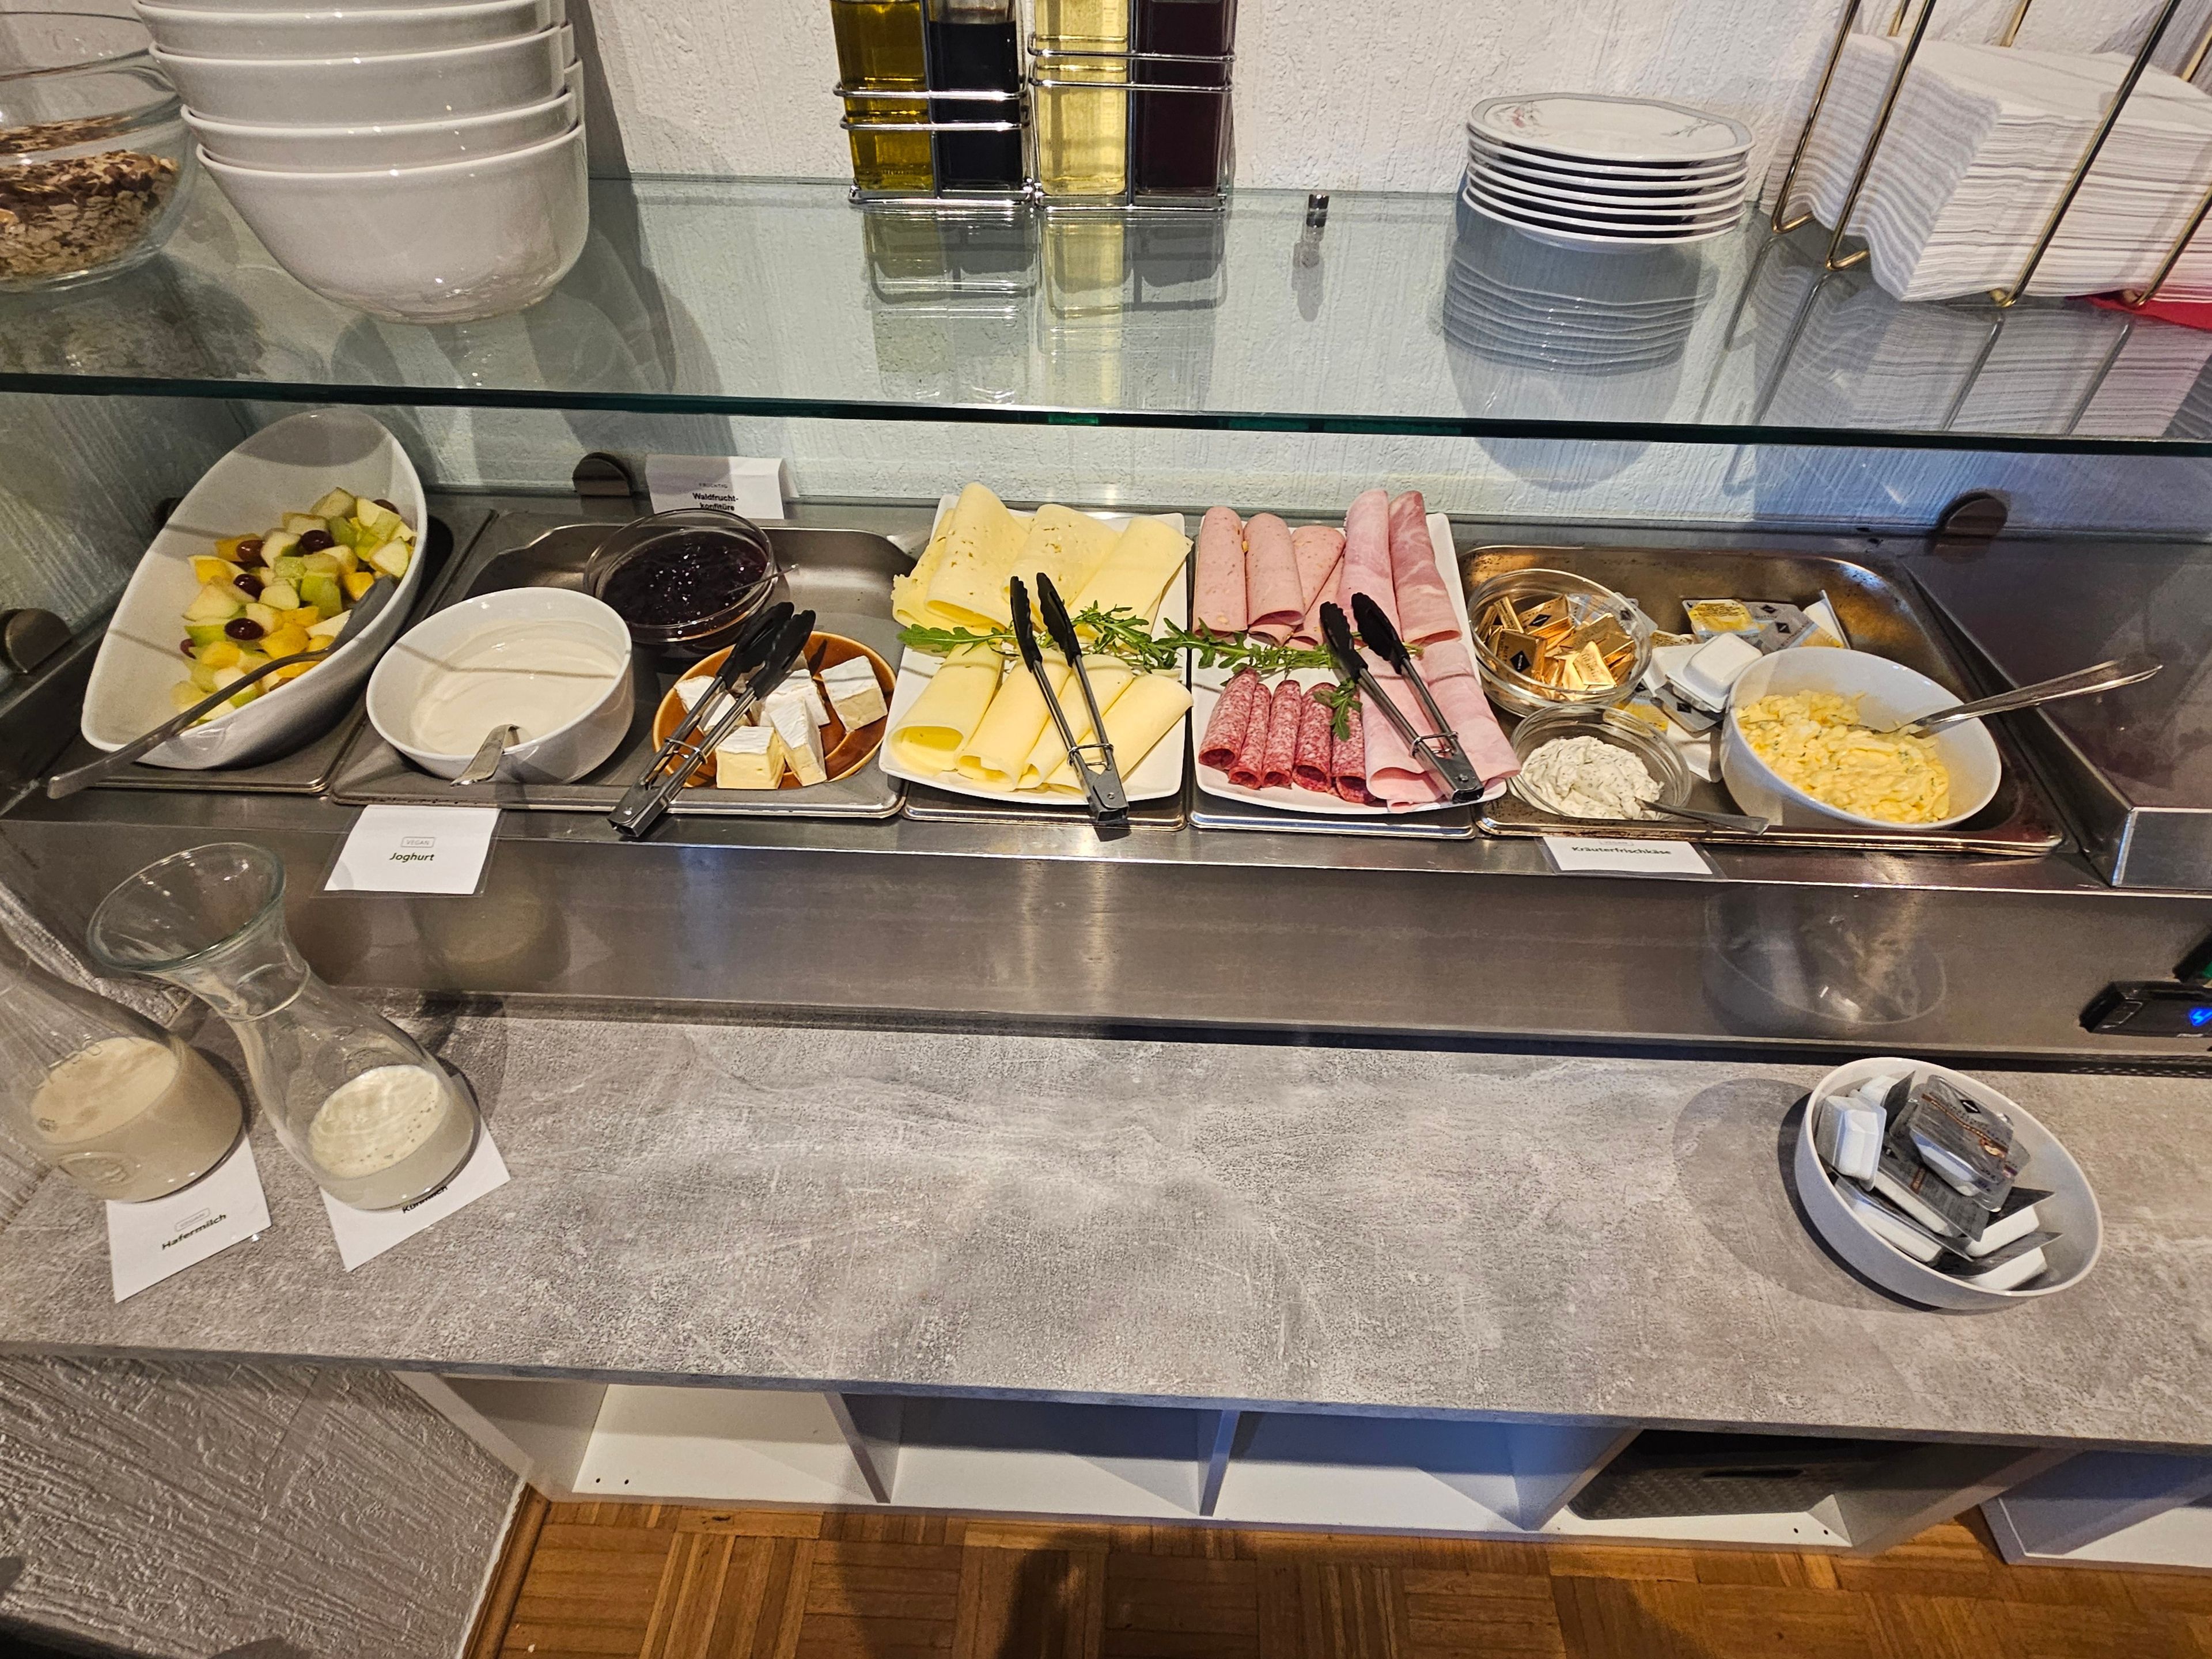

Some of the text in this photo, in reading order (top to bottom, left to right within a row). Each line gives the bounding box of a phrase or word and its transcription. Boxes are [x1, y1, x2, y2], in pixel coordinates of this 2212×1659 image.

[692, 493, 739, 502] Waldfrucht-
[699, 502, 735, 511] konfitüre
[1571, 846, 1672, 855] Kräuterfrischkäse
[389, 852, 435, 863] Joghurt
[162, 1214, 226, 1251] Hafermilch
